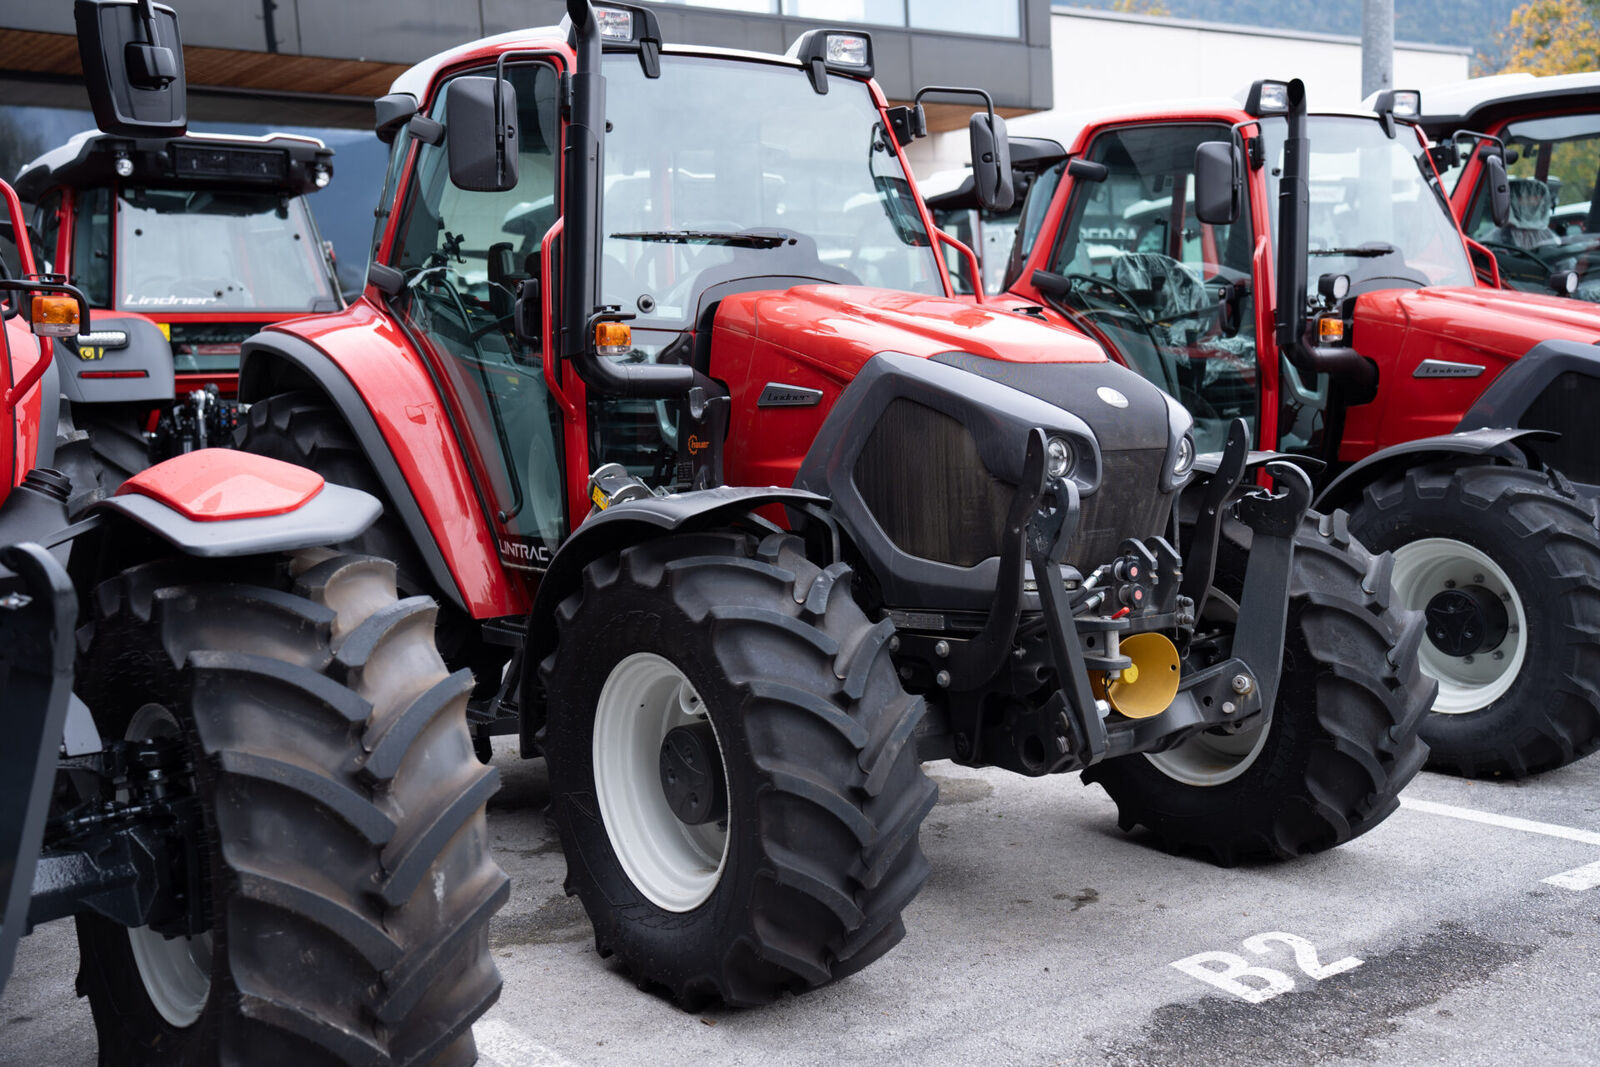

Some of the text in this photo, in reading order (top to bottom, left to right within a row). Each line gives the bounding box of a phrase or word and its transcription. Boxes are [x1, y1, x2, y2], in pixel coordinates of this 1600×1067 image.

[124, 294, 217, 305] Lindner
[498, 539, 549, 561] LINTRAC
[1168, 931, 1366, 1004] B2
